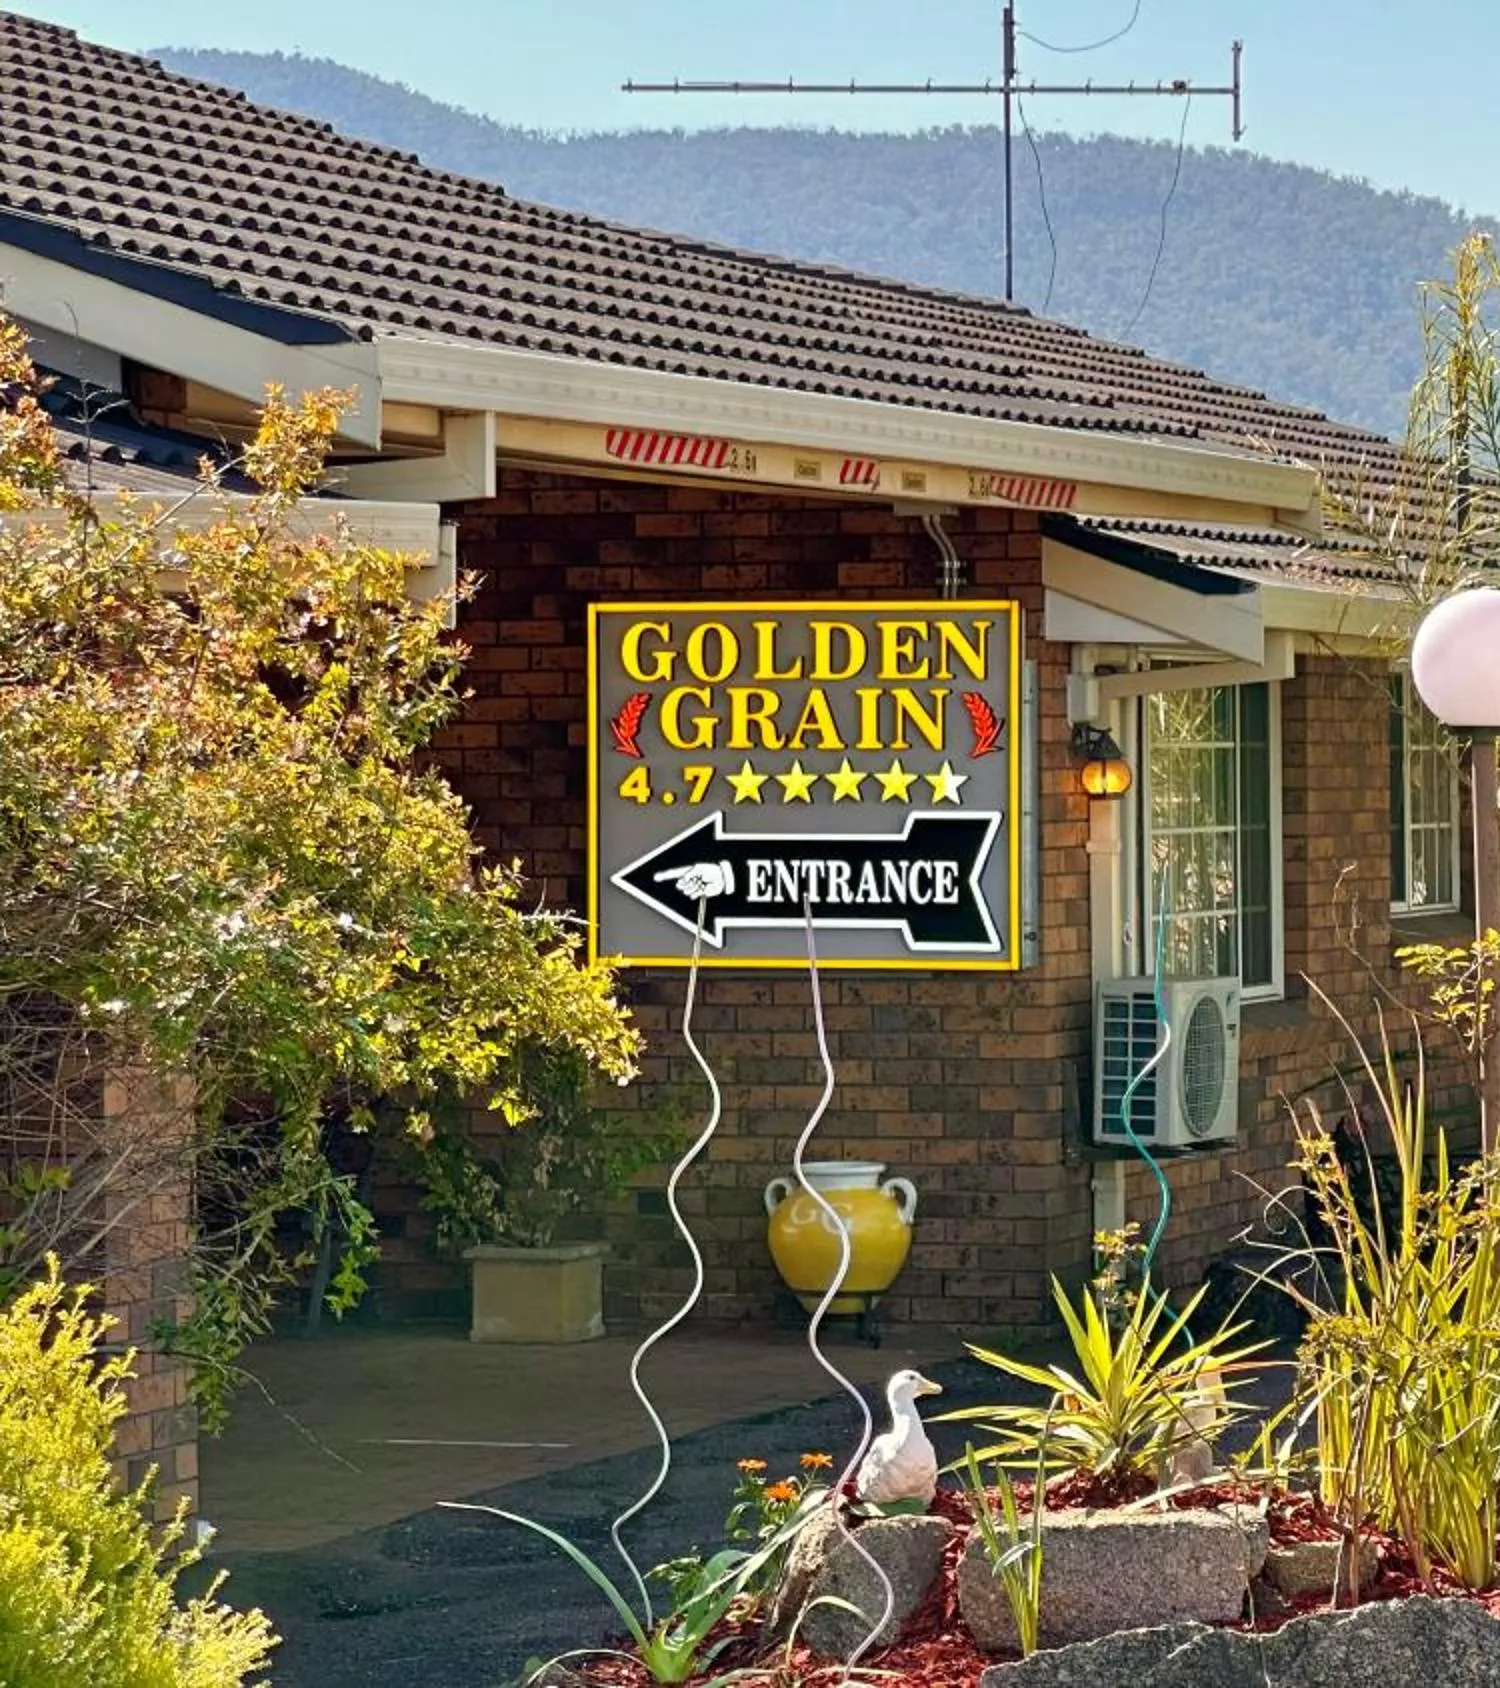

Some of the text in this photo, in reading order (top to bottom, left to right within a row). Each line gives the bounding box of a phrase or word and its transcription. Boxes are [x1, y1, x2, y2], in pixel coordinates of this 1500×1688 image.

[620, 620, 993, 683] GOLDEN
[659, 686, 952, 752] GRAIN
[618, 765, 716, 804] 4.7
[746, 859, 959, 904] ENTRANCE
